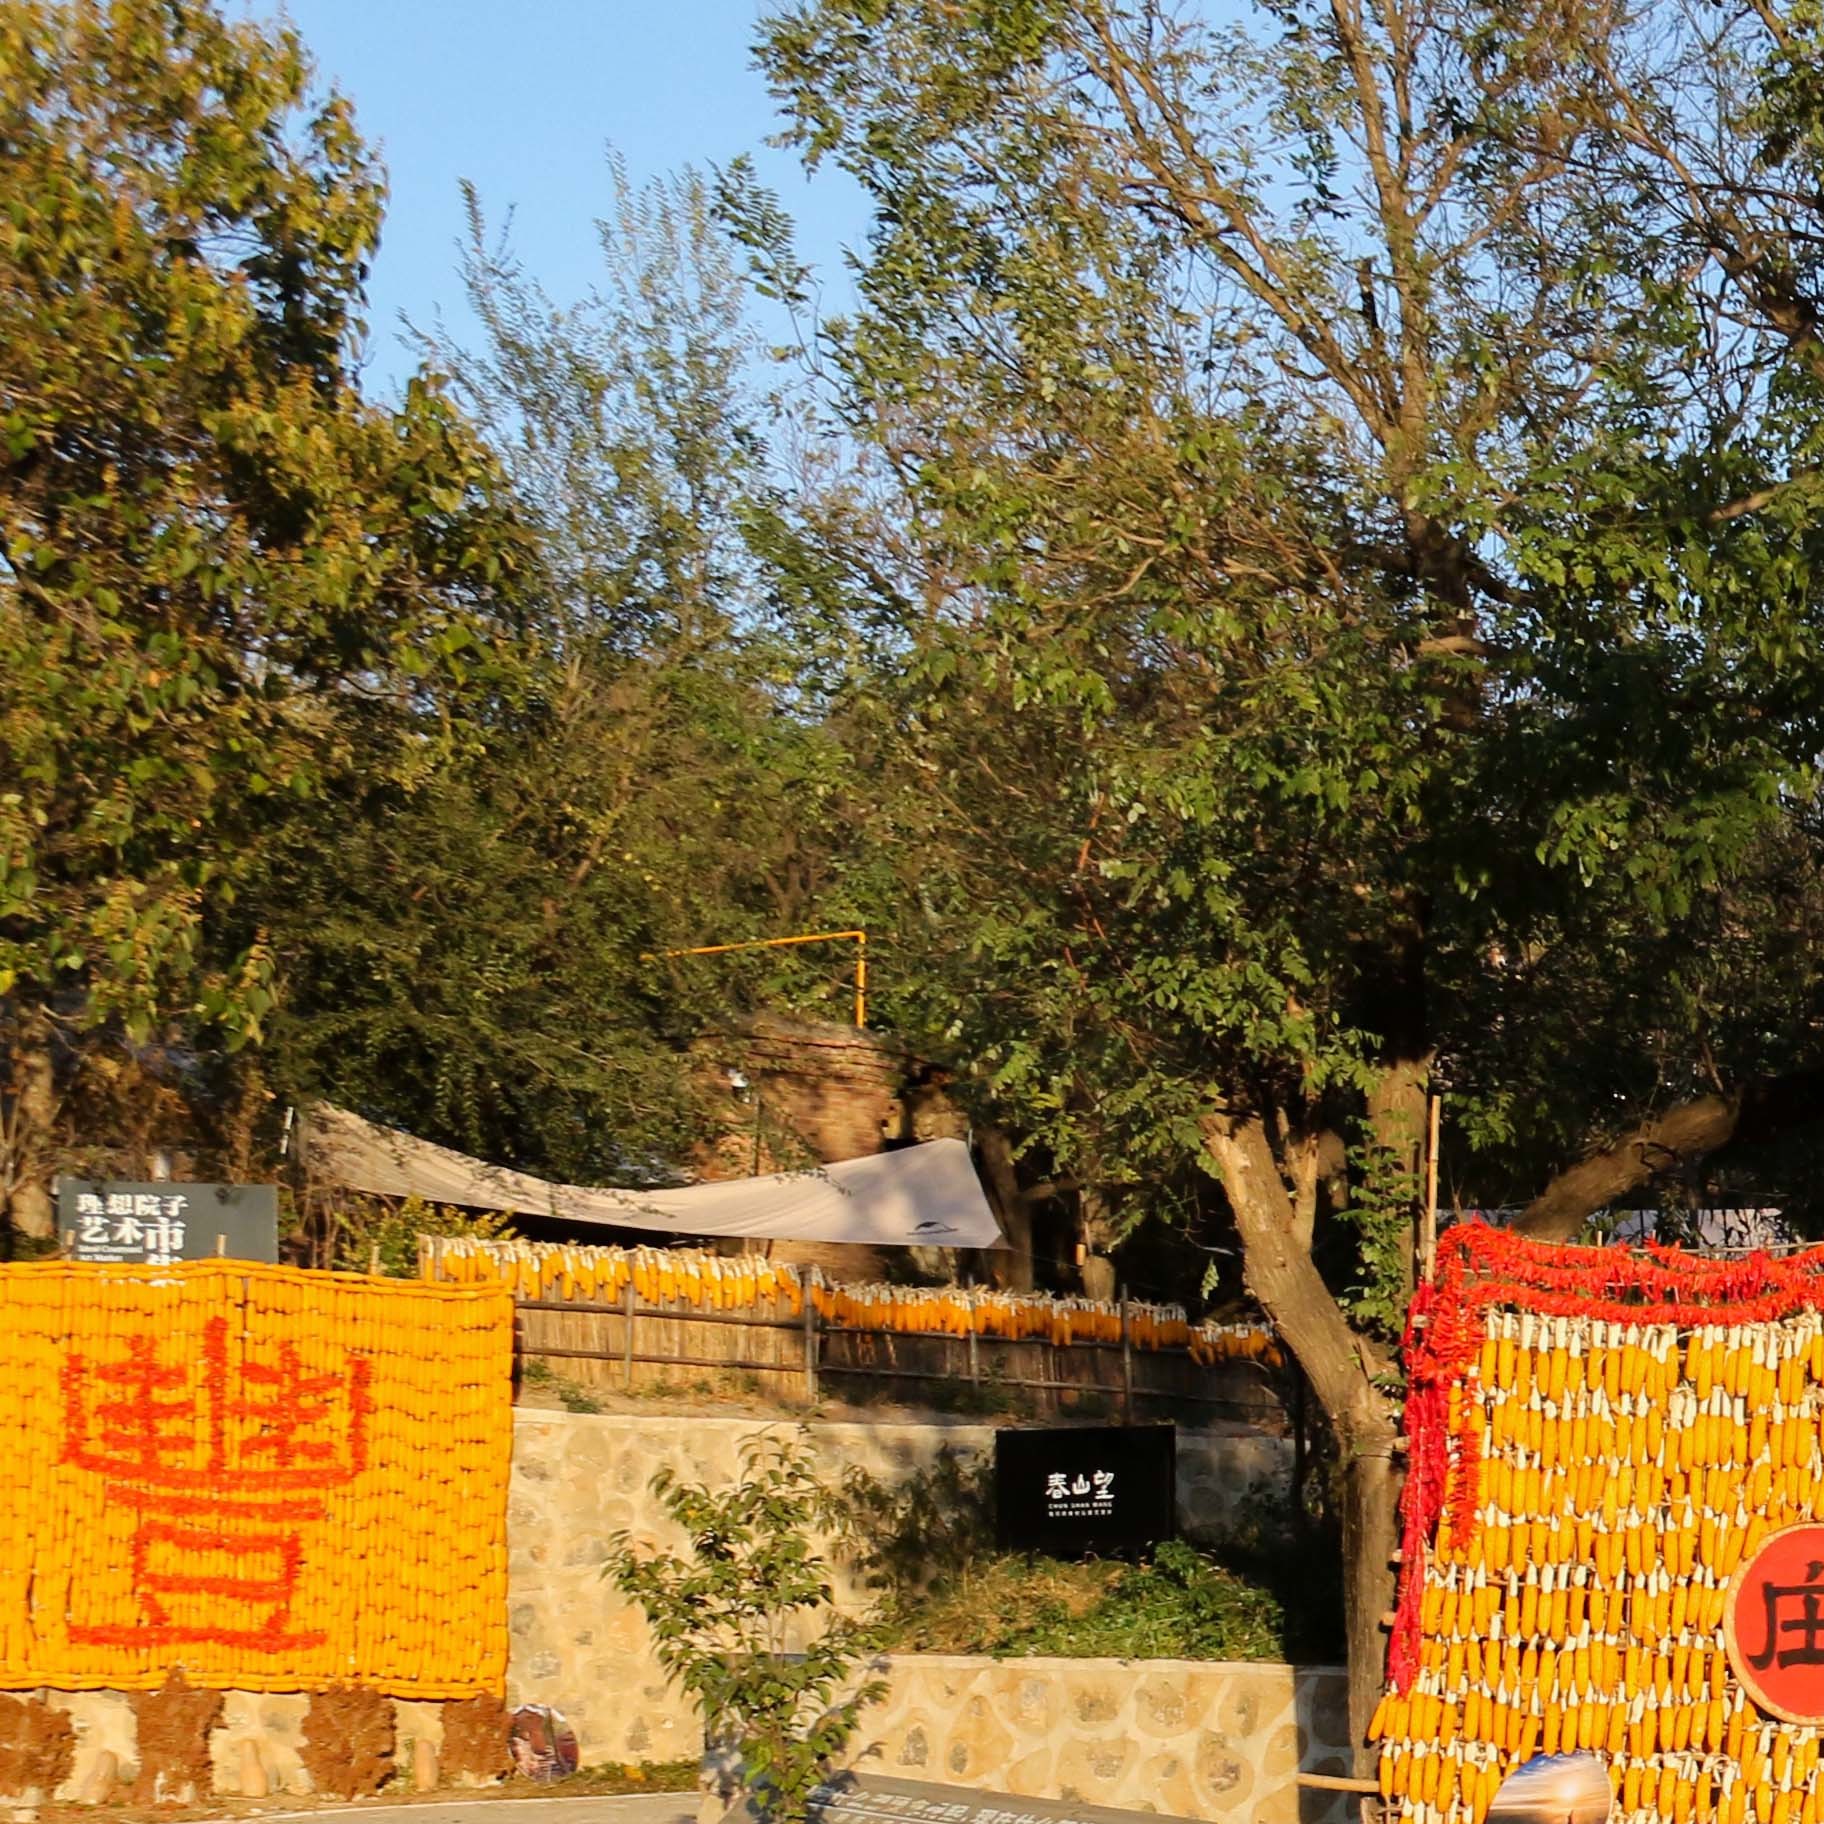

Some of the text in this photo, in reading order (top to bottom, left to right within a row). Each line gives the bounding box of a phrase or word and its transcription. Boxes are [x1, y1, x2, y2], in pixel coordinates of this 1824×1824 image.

[76, 1193, 189, 1217] 理想院子
[1045, 1469, 1115, 1499] 春山望
